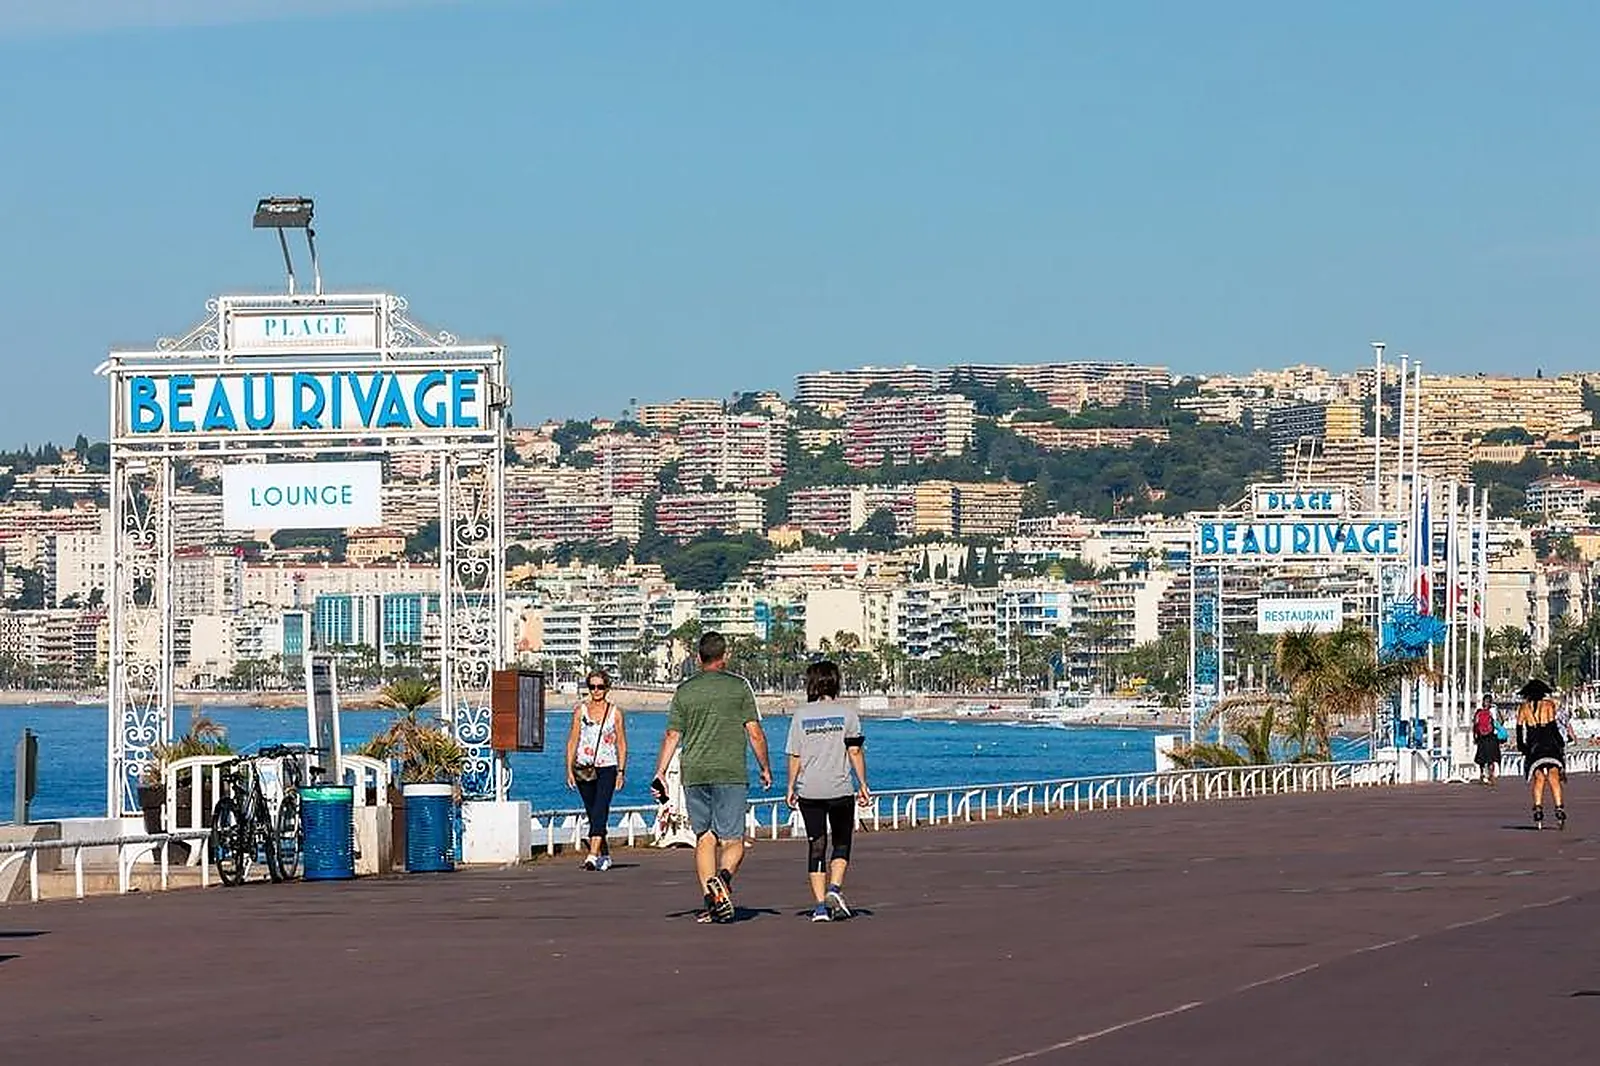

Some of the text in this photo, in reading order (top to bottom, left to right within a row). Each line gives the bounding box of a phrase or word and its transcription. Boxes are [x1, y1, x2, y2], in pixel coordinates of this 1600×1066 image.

[265, 315, 347, 337] PLAGE
[130, 369, 480, 433] BEAU RIVAGE
[250, 485, 354, 507] LOUNGE
[1268, 490, 1332, 510] PLAGE
[1201, 521, 1400, 555] BEAU RIVAGE
[1264, 609, 1335, 623] RESTAURANT
